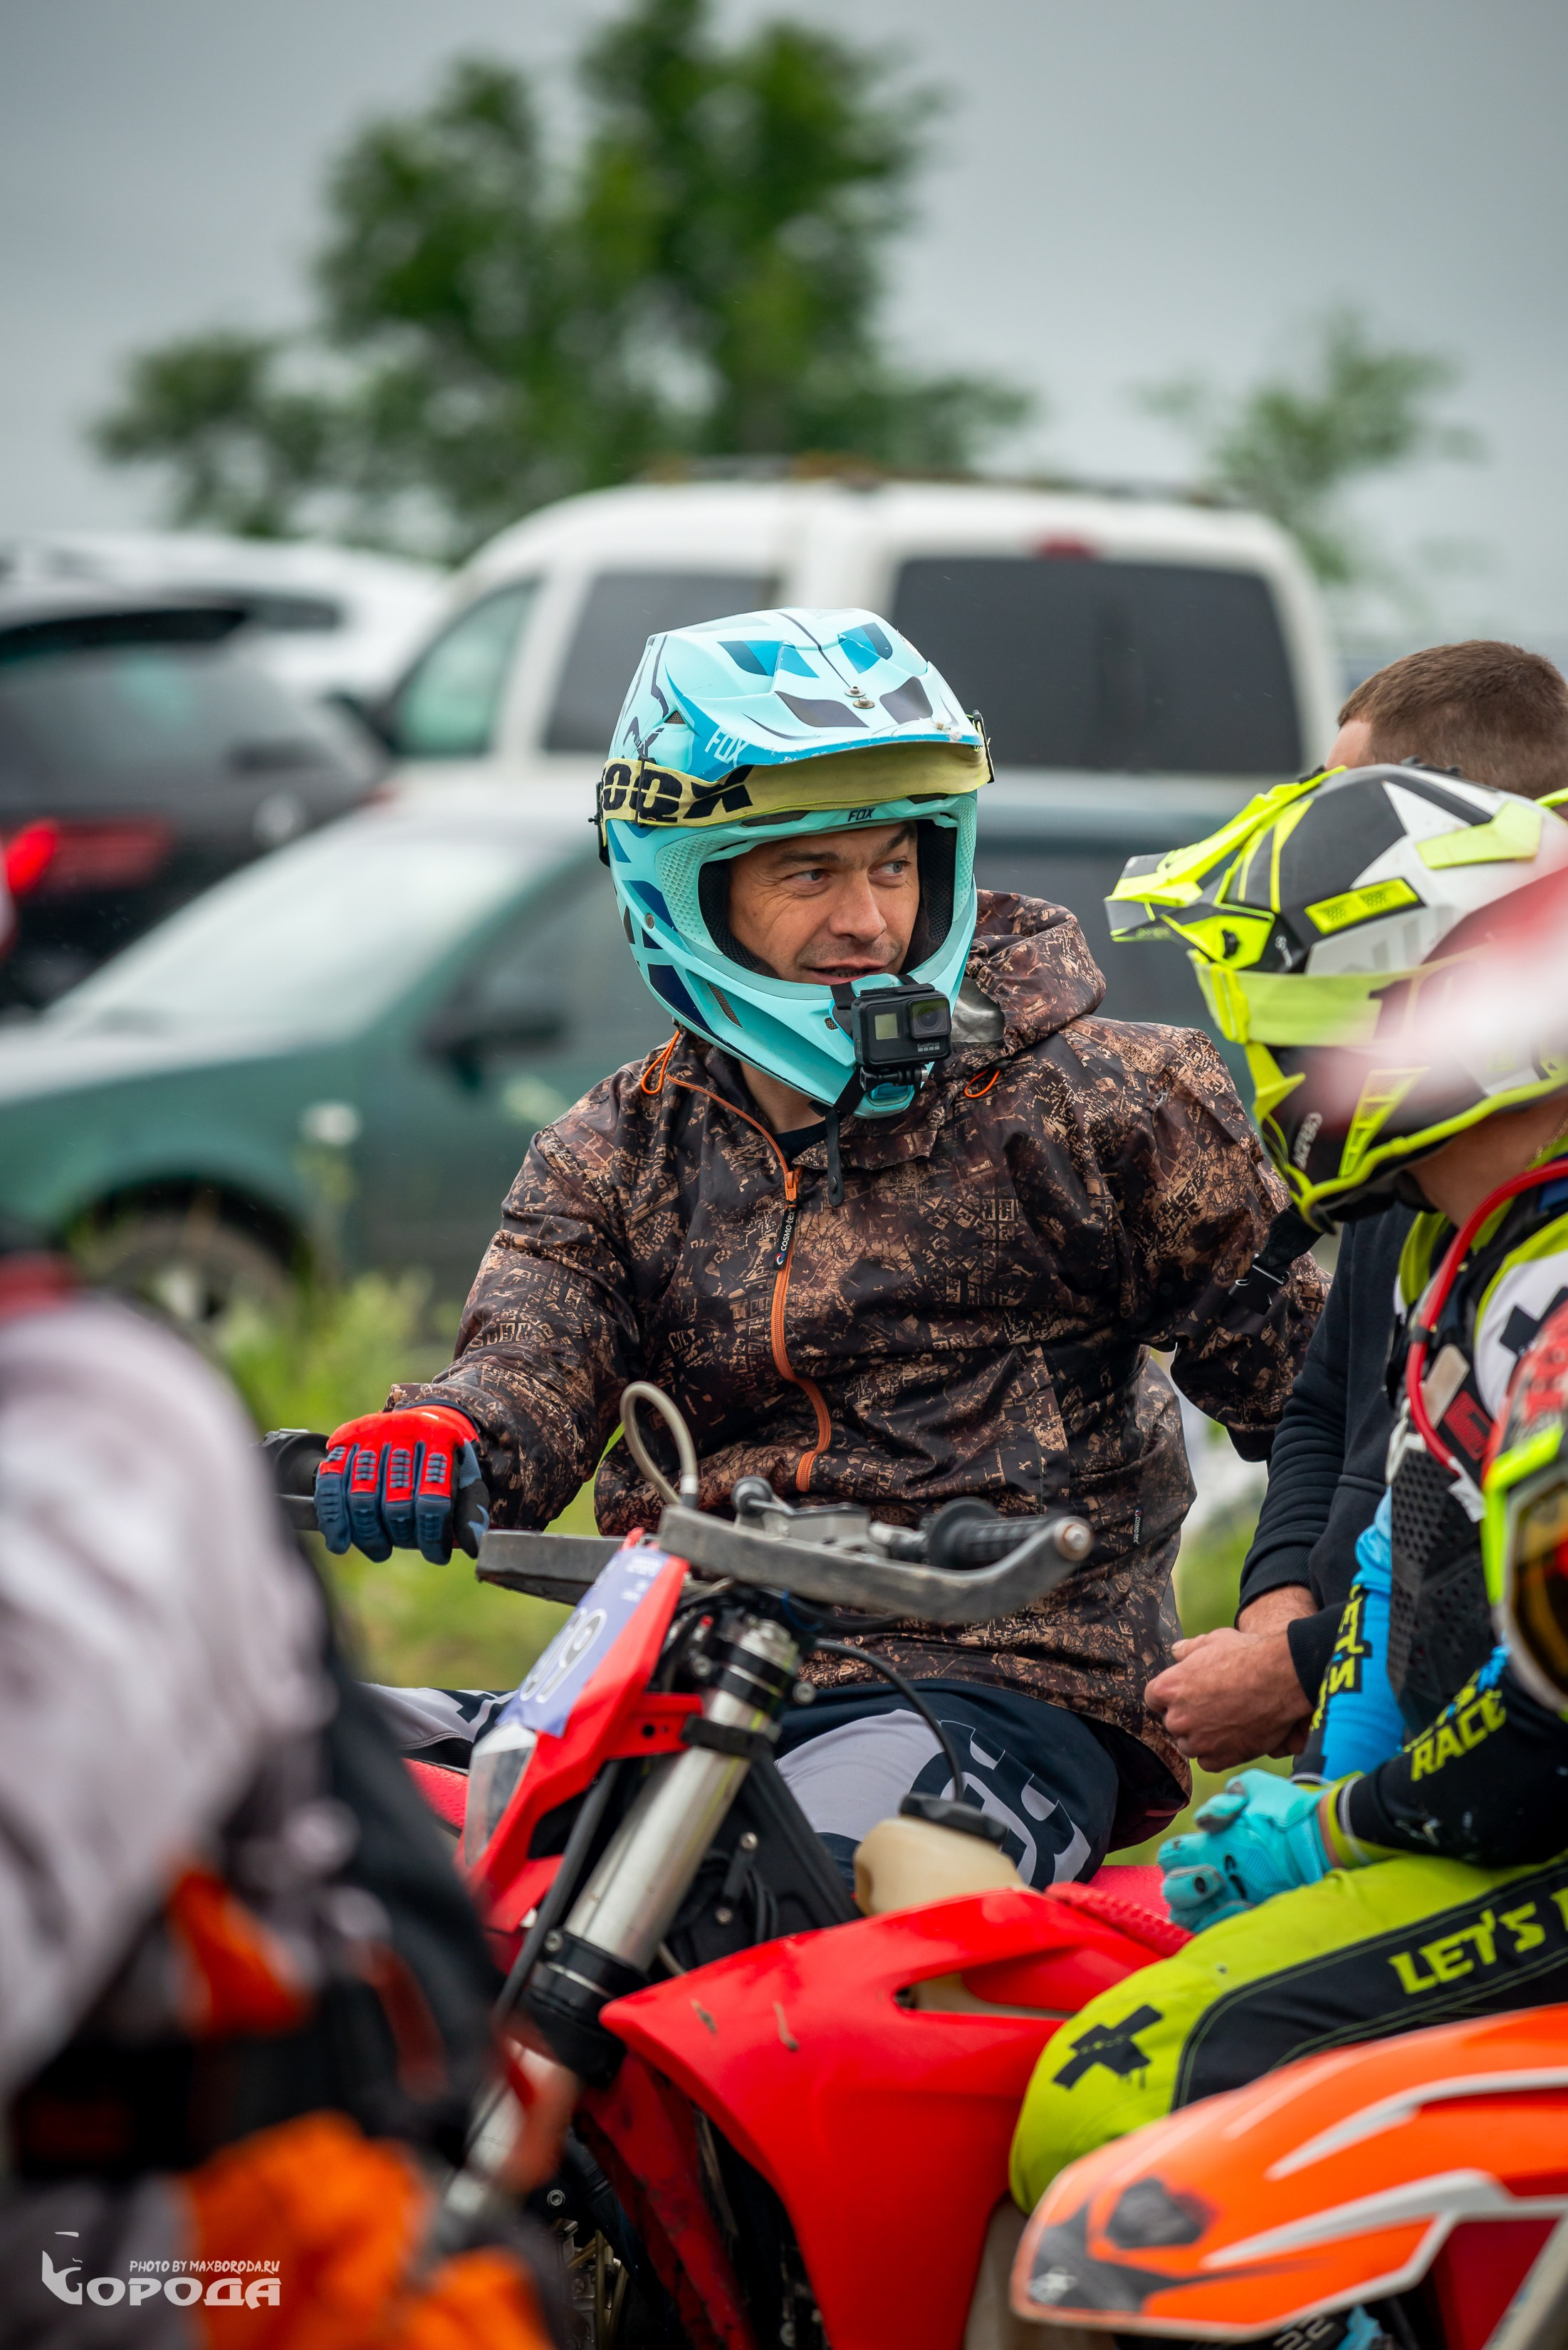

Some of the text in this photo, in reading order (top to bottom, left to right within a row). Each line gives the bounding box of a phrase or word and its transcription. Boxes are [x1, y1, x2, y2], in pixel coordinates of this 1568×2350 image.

[704, 726, 750, 768] FOX
[847, 808, 876, 822] FOX
[1410, 1688, 1507, 1781] RACE
[1386, 1901, 1547, 1995] LET'S
